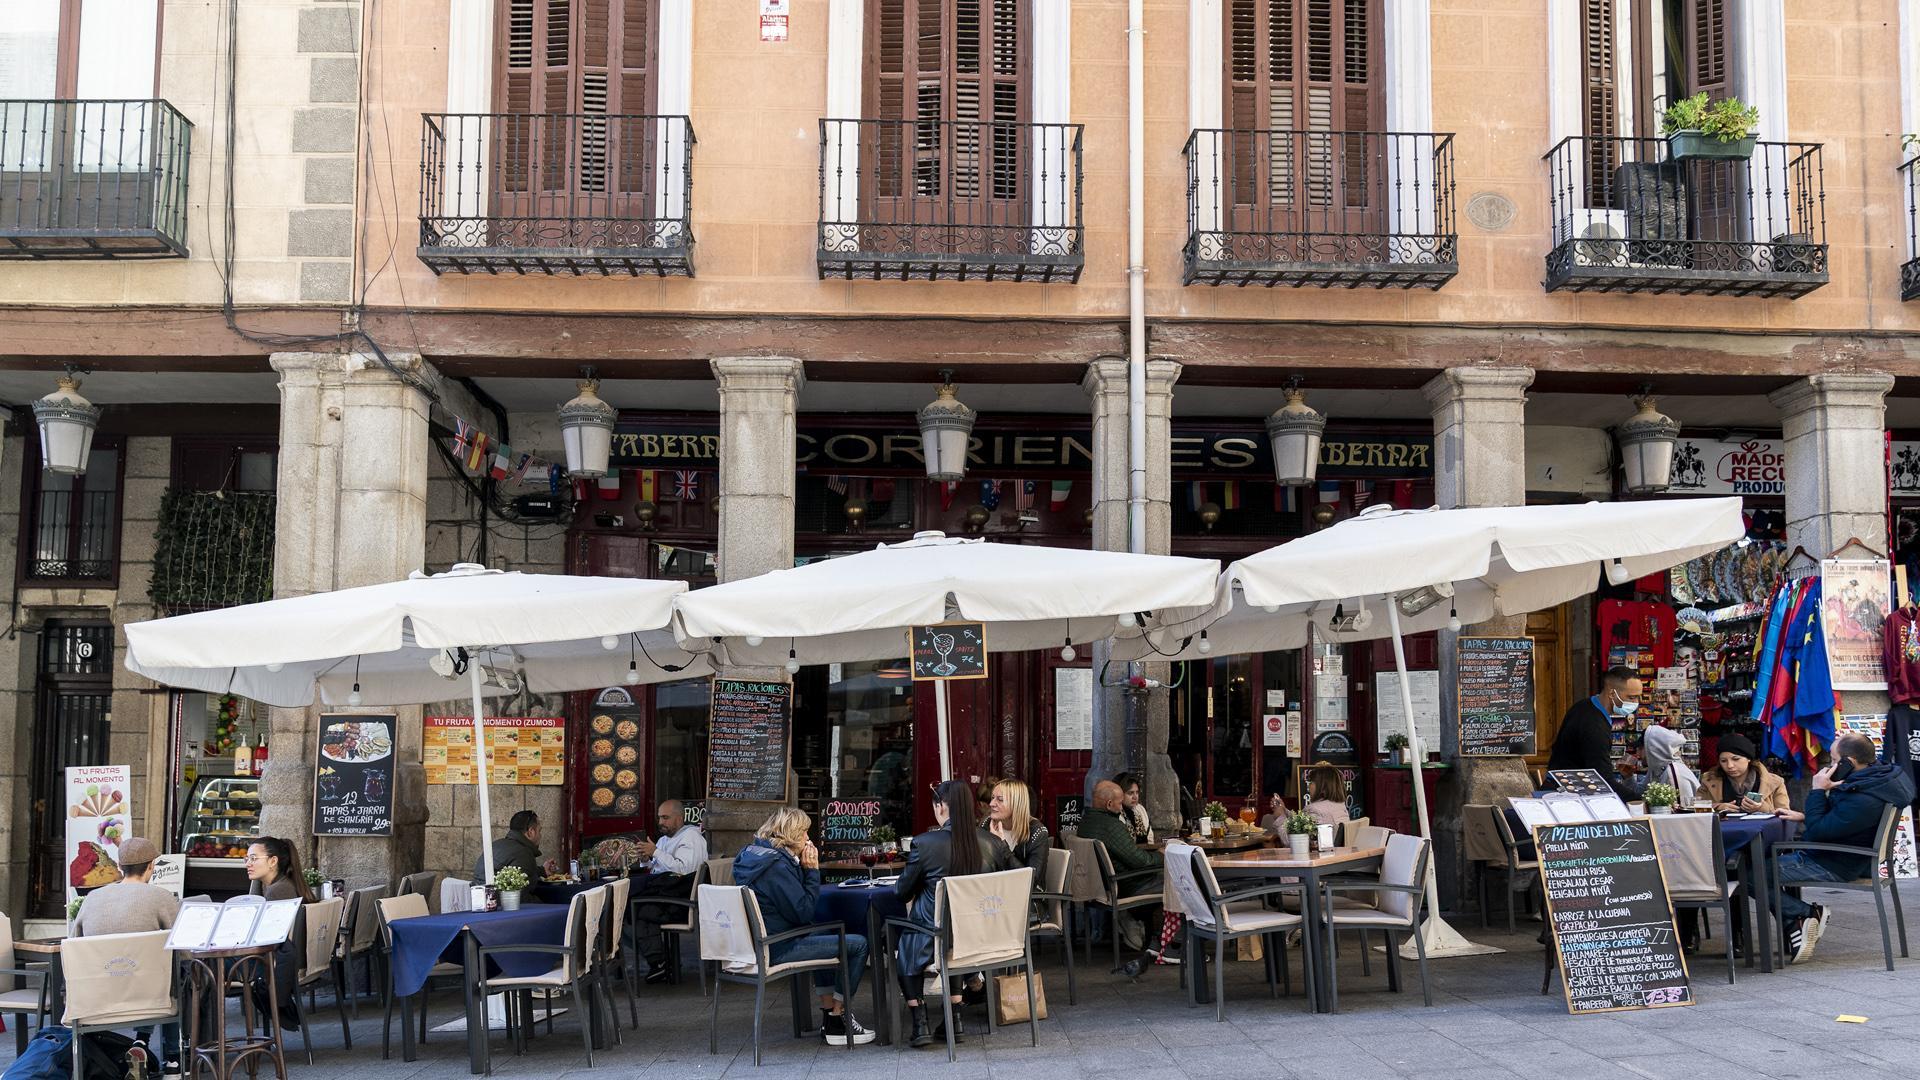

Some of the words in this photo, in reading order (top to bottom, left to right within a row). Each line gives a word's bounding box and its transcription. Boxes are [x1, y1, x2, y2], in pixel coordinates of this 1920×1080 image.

[610, 433, 720, 458] TABERN
[1318, 442, 1430, 467] BERNA
[1733, 481, 1786, 493] PRODU
[81, 643, 89, 657] 6
[1463, 640, 1488, 650] TAPAS
[1504, 640, 1533, 650] RACIONES
[523, 719, 556, 727] (ZUMOS)
[340, 791, 358, 806] 12
[321, 806, 350, 816] TAPAS
[356, 806, 385, 815] JARRA
[826, 801, 880, 815] CROQUETAS
[1064, 800, 1077, 813] 12
[827, 815, 862, 826] CASERAS
[863, 815, 873, 826] DE
[1060, 814, 1082, 822] TAPAS
[1590, 826, 1613, 838] DEL
[1570, 841, 1589, 850] MIXTA
[1550, 867, 1589, 878] ENSALADILLA
[1590, 866, 1607, 875] RUSA
[1552, 878, 1589, 889] ENSALADA
[1590, 876, 1615, 886] CESAR
[1554, 888, 1589, 898] ENSALADA
[1591, 886, 1611, 896] MIXTA
[1558, 911, 1585, 921] ARROZ
[1588, 910, 1594, 919] A
[1594, 910, 1605, 919] LA
[1605, 907, 1631, 918] CUBANA
[1560, 921, 1598, 931] GAZPACHO
[1563, 930, 1619, 943] HAMBURGUESA
[1619, 928, 1651, 939] COMPLETA
[1612, 938, 1647, 948] CASERAS
[1568, 949, 1609, 960] CALAMARES
[1621, 947, 1652, 956] ANDALUZA
[1569, 957, 1605, 967] ESCALOPE
[1606, 957, 1615, 966] DE
[1654, 953, 1675, 962] POLLO
[1570, 966, 1596, 977] FILETE
[1596, 965, 1606, 975] DE
[1607, 964, 1635, 973] TERNERA
[1652, 961, 1674, 970] POLLO
[1573, 976, 1603, 986] SARTEN
[1605, 977, 1616, 986] DE
[1616, 974, 1644, 984] HUEVOS
[1645, 972, 1659, 982] CON
[1576, 987, 1598, 997] DADOS
[1599, 985, 1608, 994] DE
[1610, 984, 1642, 993] BACALAO
